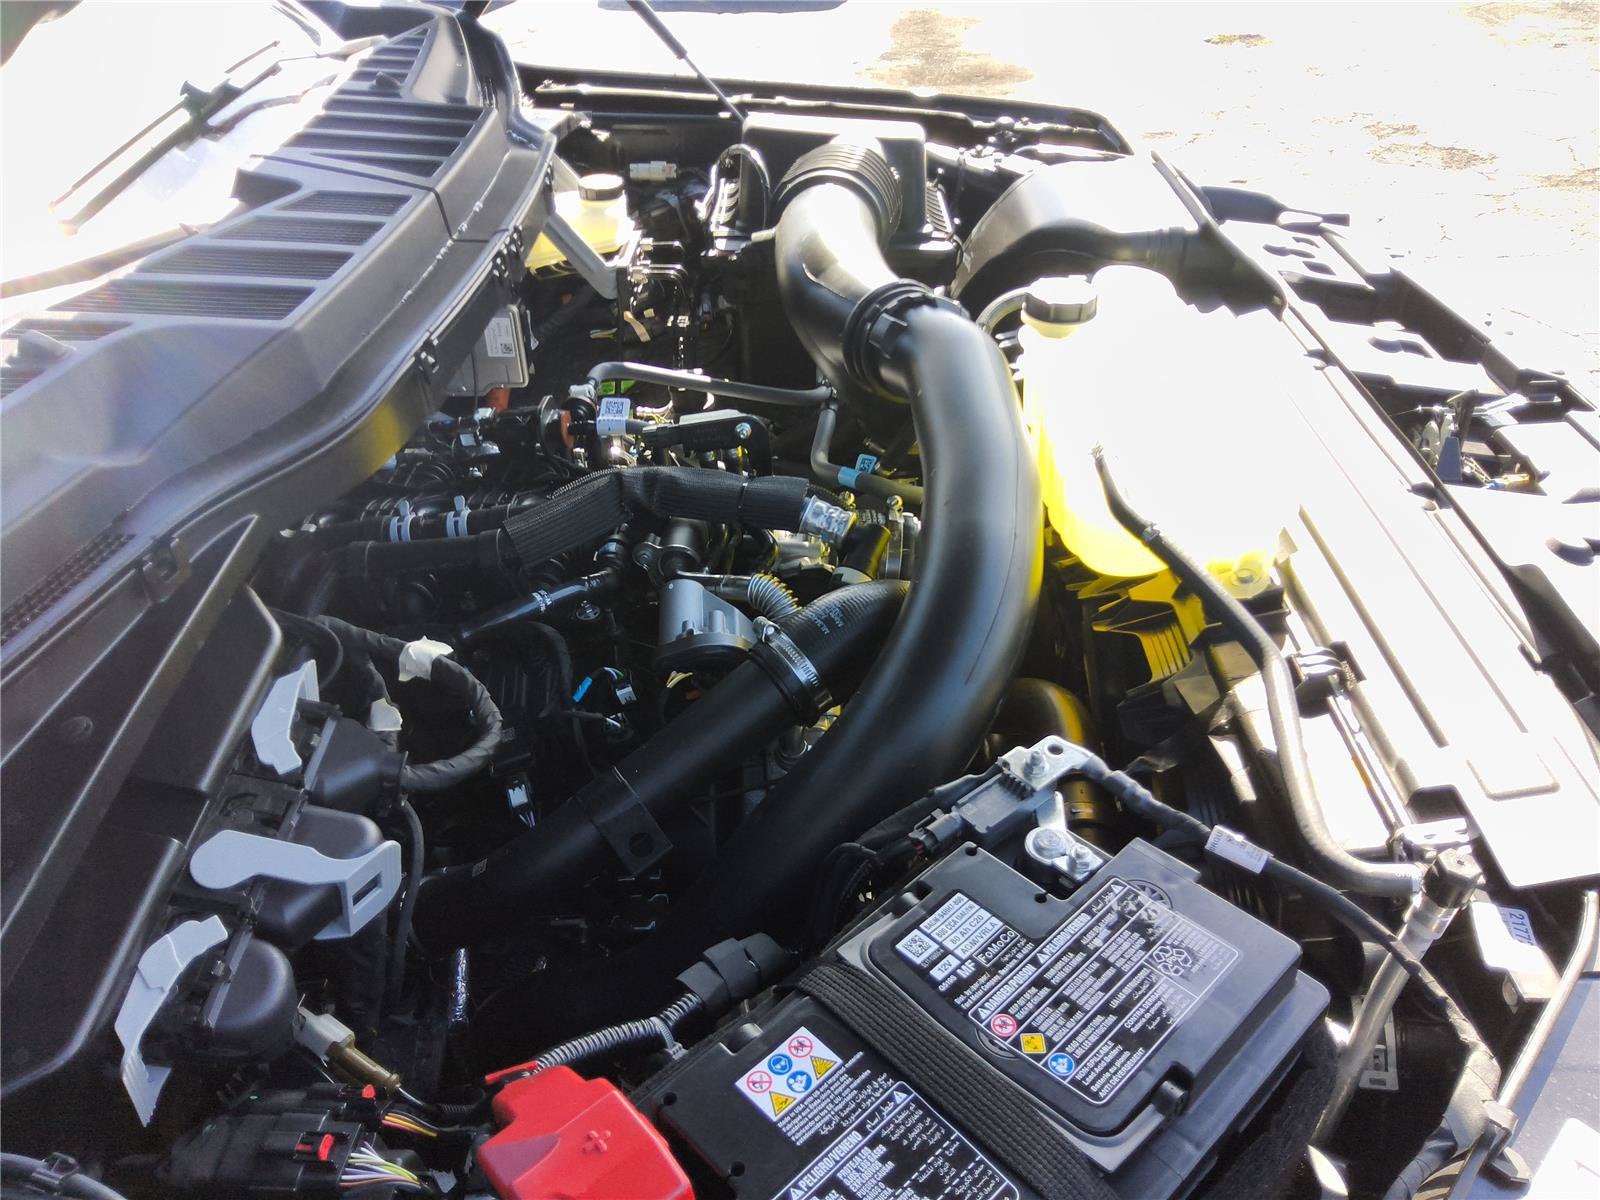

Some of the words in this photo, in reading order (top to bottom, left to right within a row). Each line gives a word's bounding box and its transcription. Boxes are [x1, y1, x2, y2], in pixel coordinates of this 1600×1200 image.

[949, 935, 961, 944] 80
[957, 926, 971, 936] Ah
[967, 914, 984, 927] C20
[958, 921, 999, 954] AGM/VRLA
[976, 928, 1017, 962] FoMoCo
[1041, 912, 1092, 955] PELIGRO/VENENO
[935, 959, 954, 973] 12V
[955, 959, 979, 978] MF
[983, 963, 1037, 1010] DANGER/POISON
[1123, 1007, 1145, 1028] CONTRA
[1073, 1040, 1115, 1080] NON-SPILLABLE
[1081, 1070, 1097, 1085] Lead
[1092, 1060, 1107, 1073] Acid
[1103, 1043, 1124, 1063] Battery
[1089, 1071, 1111, 1092] Batterie
[1107, 1065, 1117, 1073] au
[1112, 1049, 1132, 1067] plomb
[1097, 1083, 1112, 1097] ANTI
[1107, 1046, 1146, 1085] DÉVERSEMENT
[793, 1102, 805, 1113] USA
[810, 1089, 820, 1098] US
[796, 1129, 864, 1191] PELIGRO/VENENO
[835, 1155, 863, 1180] PROTEJA
[857, 1145, 872, 1159] LOS
[857, 1158, 871, 1172] LOS
[866, 1143, 887, 1162] GASES
[847, 1159, 883, 1192] EXPLOSIVOS
[855, 1177, 878, 1198] PUEDEN
[872, 1159, 896, 1181] CAUSAR
